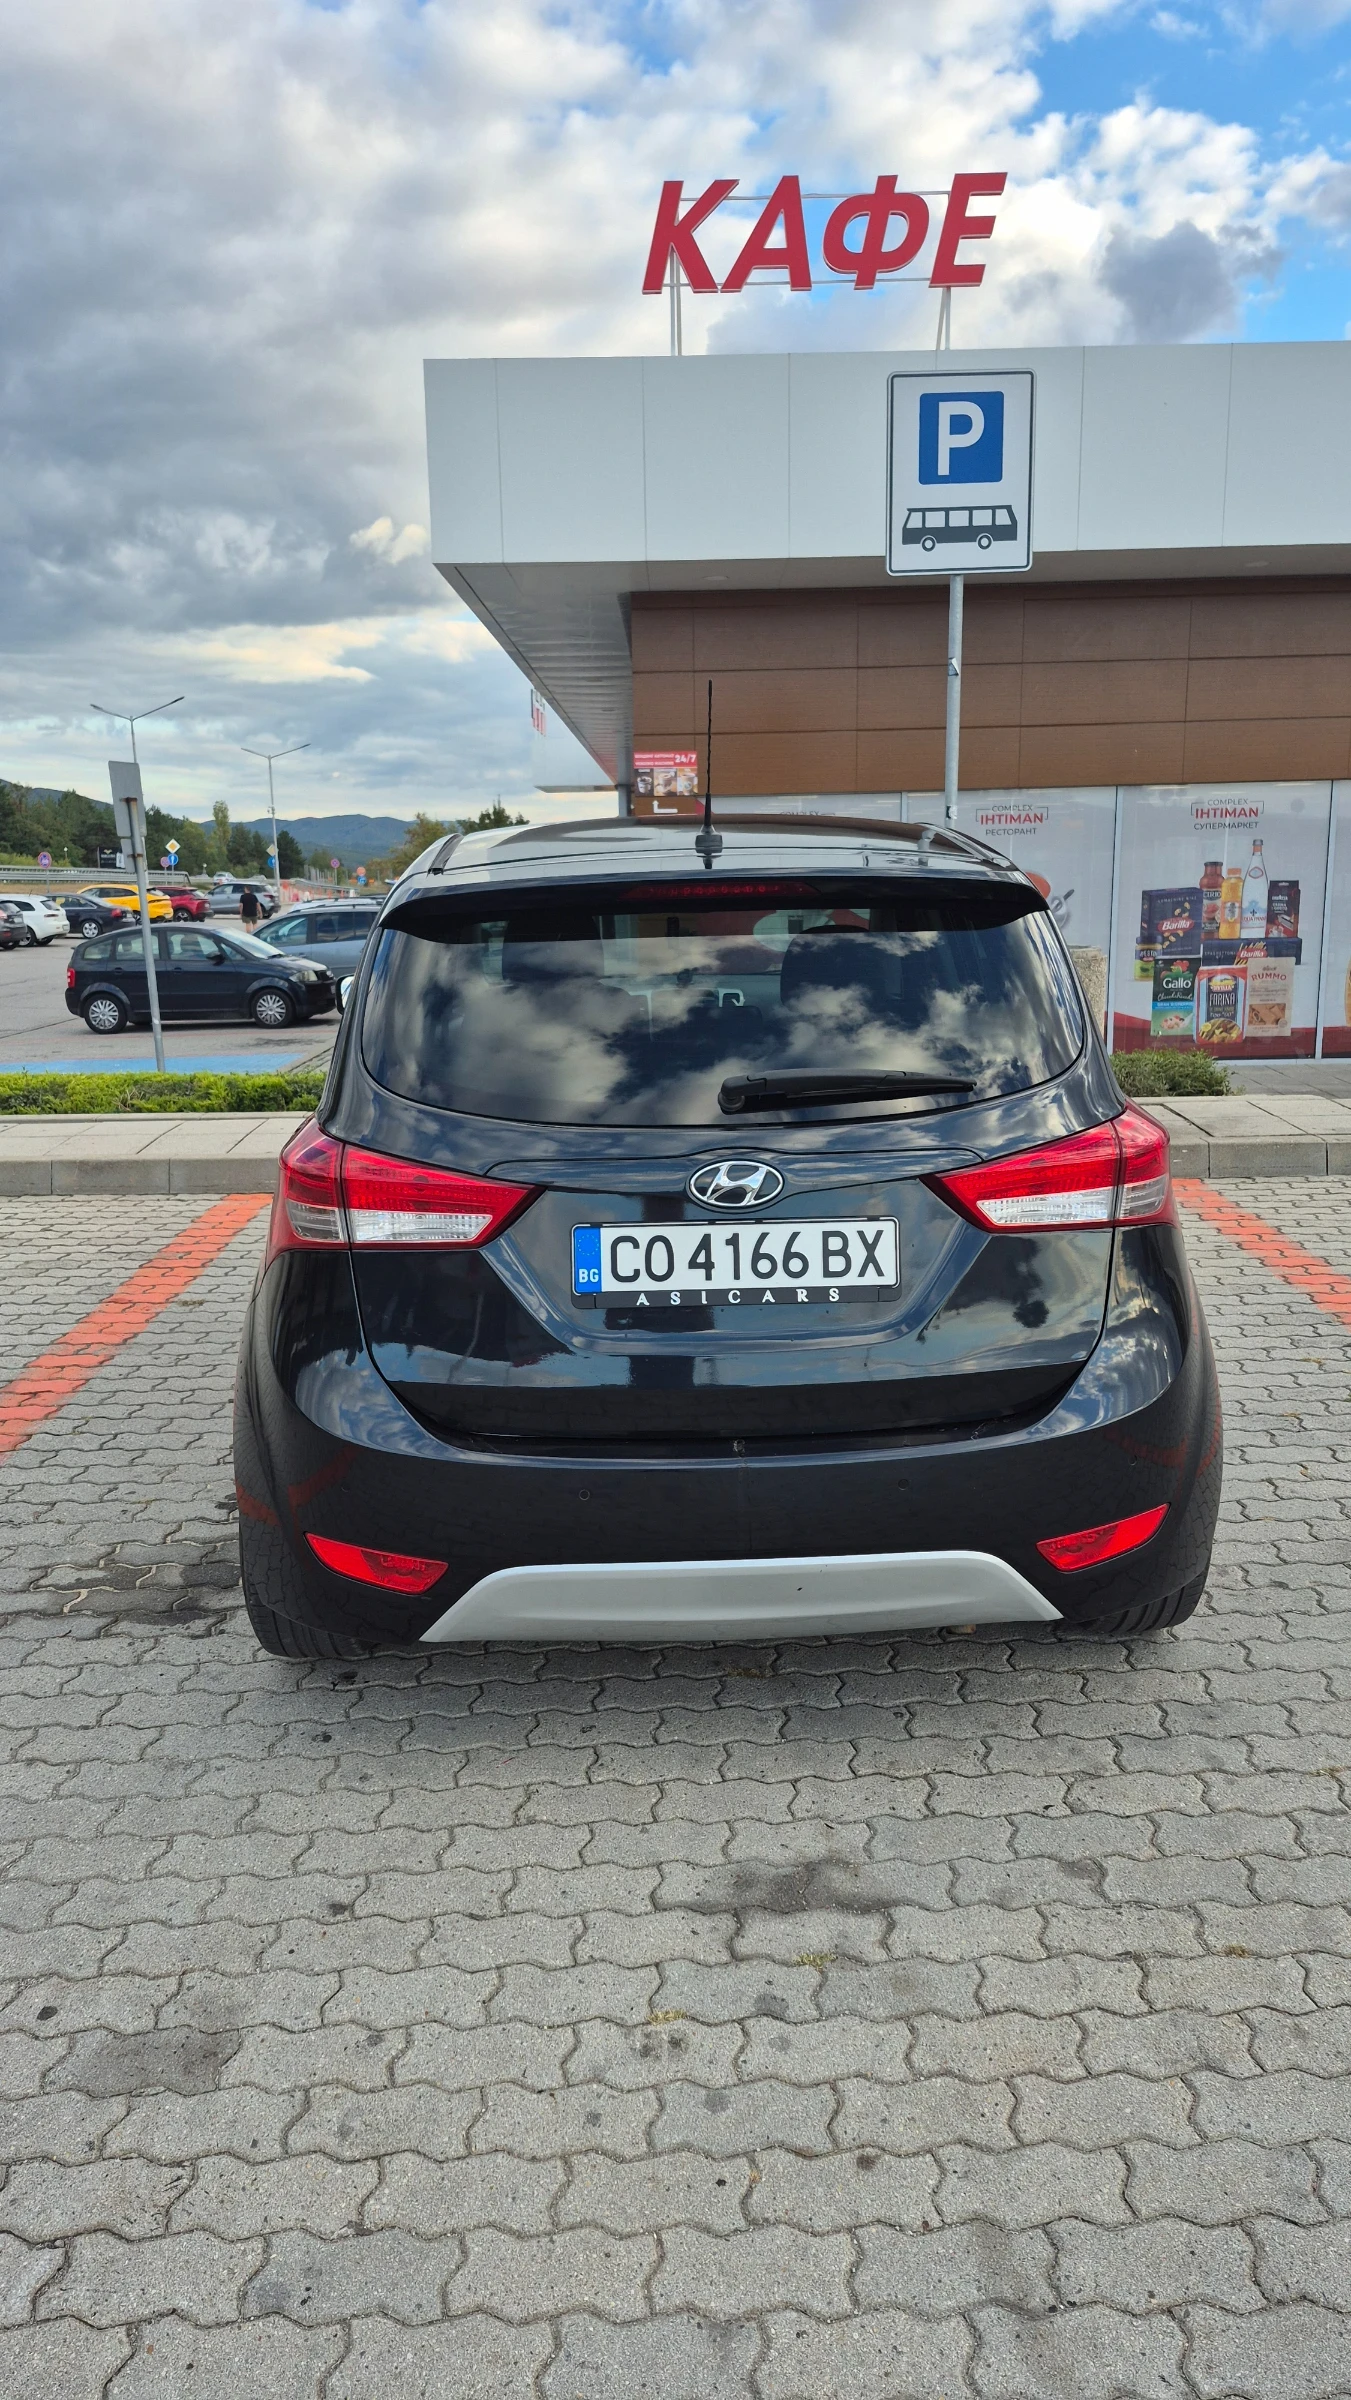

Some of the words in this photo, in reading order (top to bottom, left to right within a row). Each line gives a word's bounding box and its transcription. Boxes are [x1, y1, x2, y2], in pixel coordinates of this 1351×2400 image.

[641, 171, 1009, 295] КАФЕ
[937, 400, 985, 476] P
[674, 753, 697, 763] 24/7
[991, 804, 1033, 813] COMPLEX
[1207, 798, 1249, 807] COMPLEX
[980, 812, 1044, 825] IHTIMAN
[1195, 806, 1259, 819] IHTIMAN
[985, 827, 1037, 837] РЕСТОРАНТ
[1193, 821, 1260, 831] СУПЕРМАРКЕТ
[1162, 919, 1191, 931] Barilla
[1240, 949, 1265, 958] Barilla
[1251, 972, 1287, 981] RUMMO
[1162, 977, 1192, 989] Gallo
[1209, 992, 1236, 1007] FARINA
[687, 1231, 810, 1282] 4166
[821, 1229, 885, 1279] BX
[578, 1268, 599, 1283] BG
[635, 1287, 840, 1307] ASICARS
